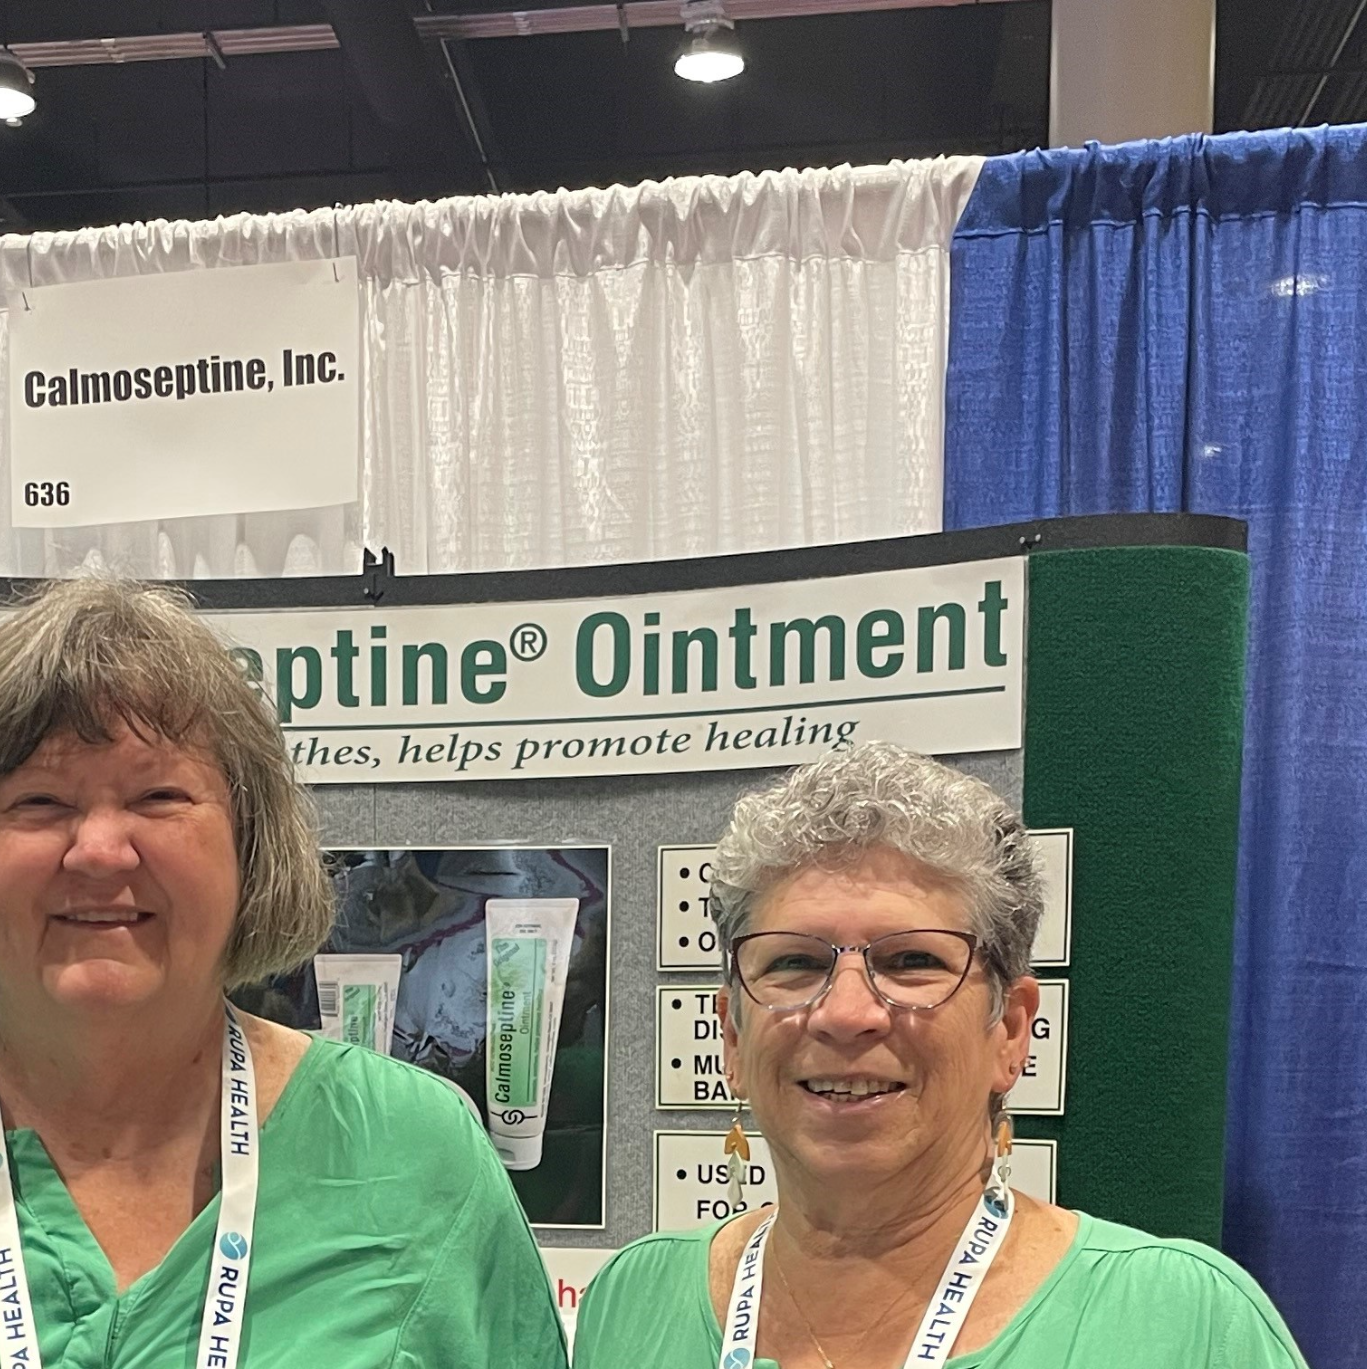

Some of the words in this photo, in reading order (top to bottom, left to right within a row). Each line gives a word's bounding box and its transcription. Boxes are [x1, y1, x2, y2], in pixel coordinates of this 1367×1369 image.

[24, 353, 274, 409] Calmoseptine,
[282, 348, 345, 386] Inc.
[24, 481, 71, 507] 636
[575, 581, 1008, 698] Ointment
[291, 736, 381, 769] thes,
[398, 731, 502, 771] helps
[515, 729, 691, 769] promote
[706, 714, 860, 753] healing
[519, 991, 532, 1035] Ointment
[228, 1024, 246, 1072] RUPA
[230, 1078, 250, 1156] HEALTH
[958, 1216, 998, 1265] RUPA
[214, 1266, 240, 1327] RUPA
[733, 1285, 755, 1342] RUPA
[917, 1271, 973, 1360] HEALTH
